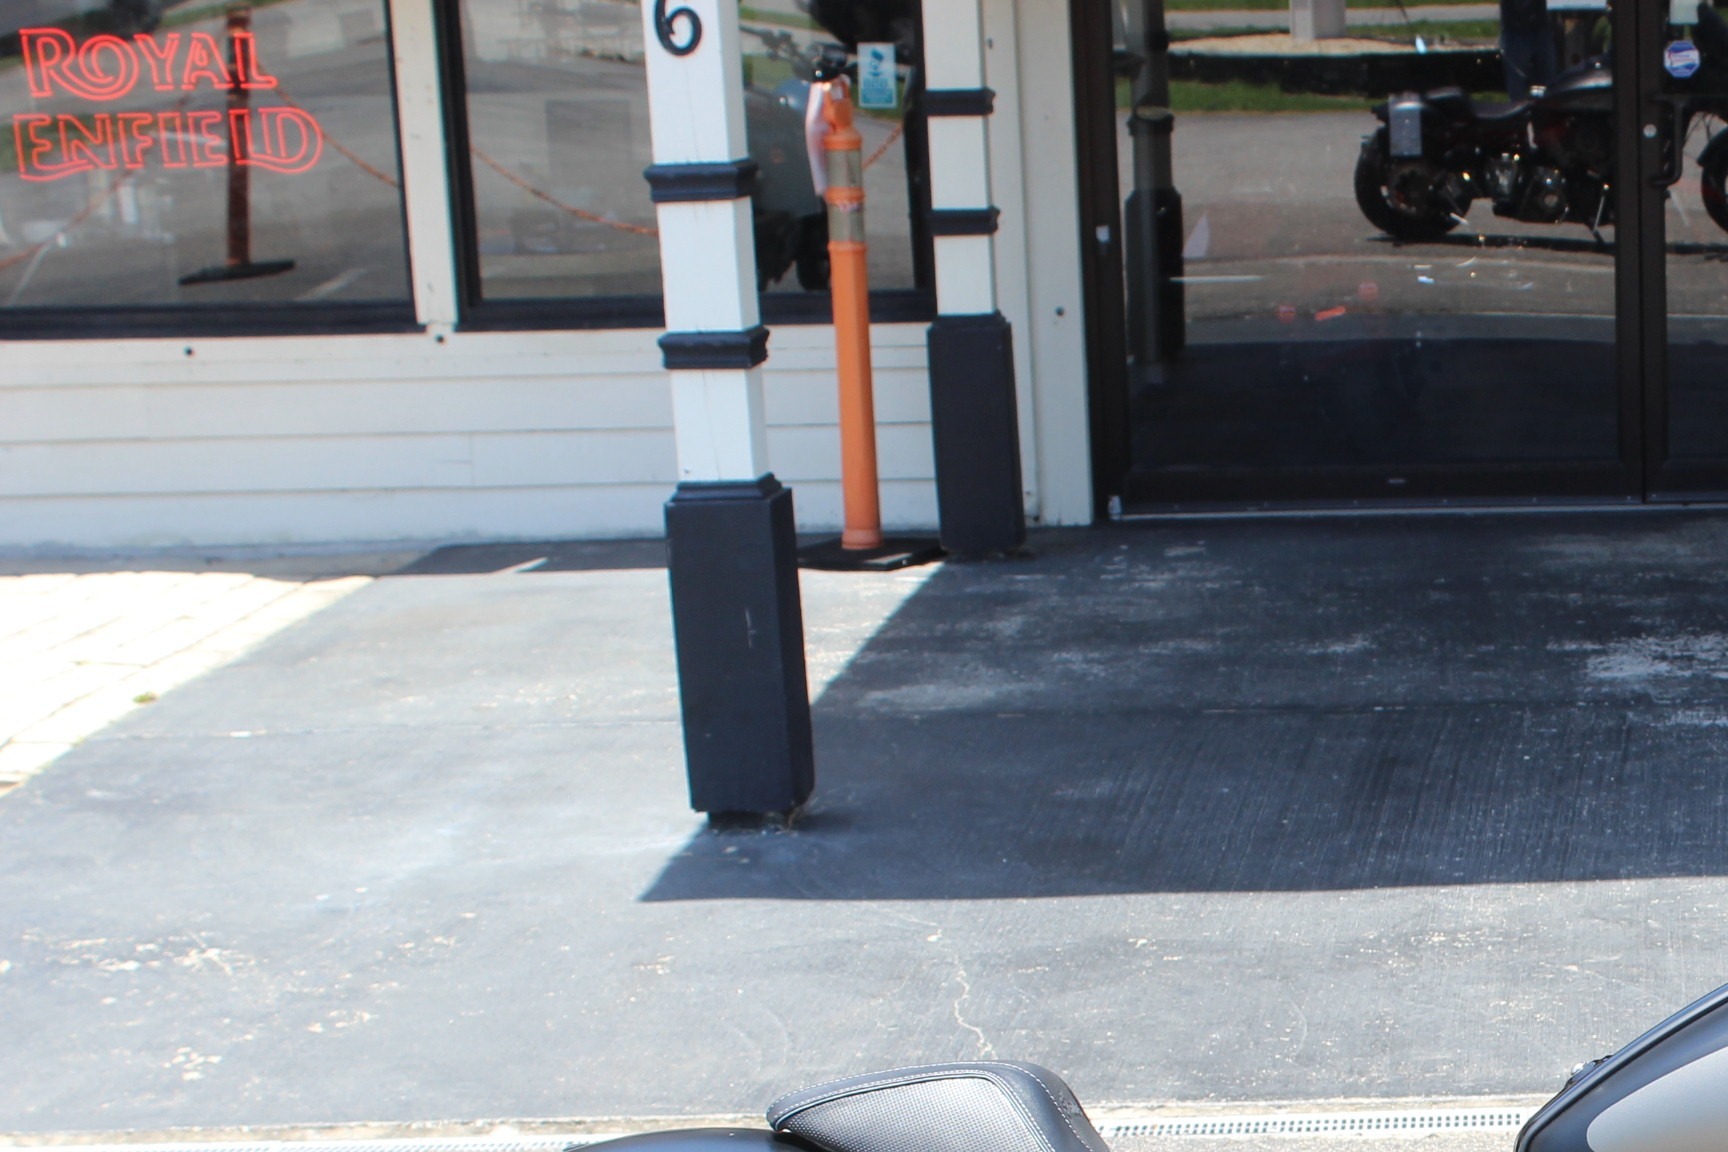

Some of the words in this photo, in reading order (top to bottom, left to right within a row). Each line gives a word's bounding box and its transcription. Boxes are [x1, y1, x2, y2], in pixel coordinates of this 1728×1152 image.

[19, 27, 278, 100] ROYAL
[654, 0, 703, 56] 6
[12, 107, 323, 182] ENFIELD
